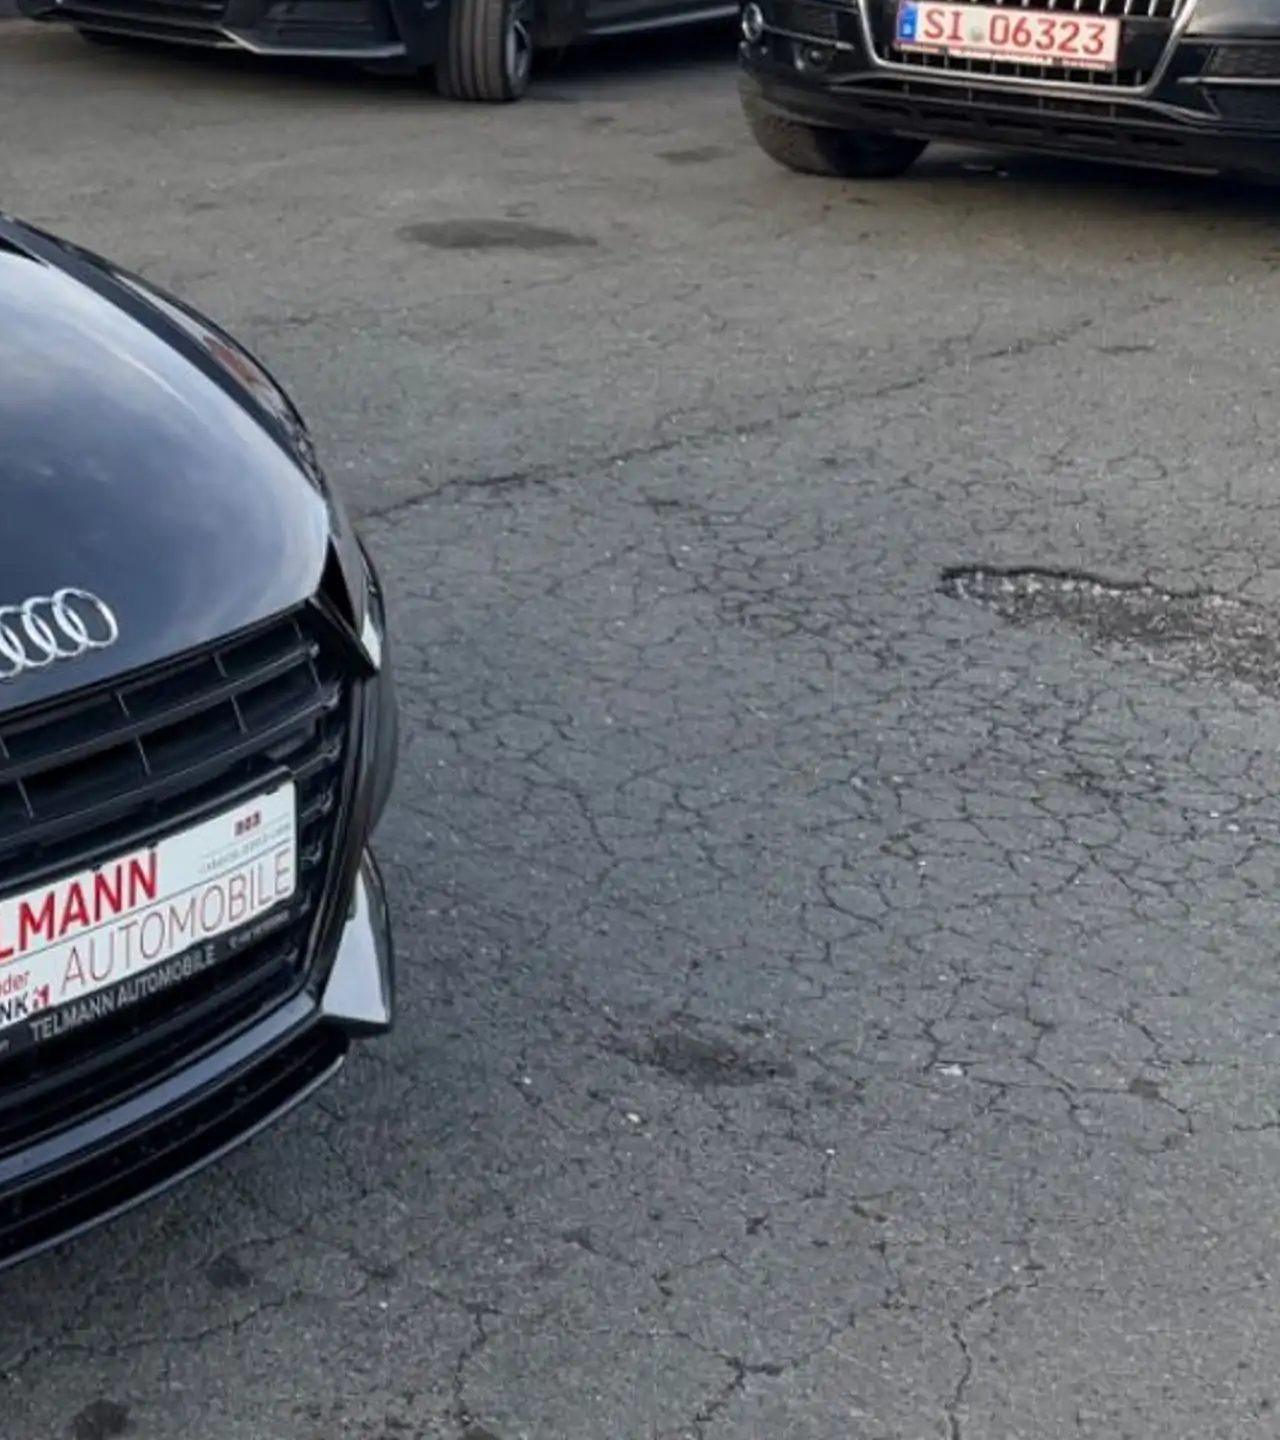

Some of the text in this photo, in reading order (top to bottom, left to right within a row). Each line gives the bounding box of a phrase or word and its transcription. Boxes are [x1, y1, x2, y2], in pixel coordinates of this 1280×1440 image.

[923, 8, 1106, 56] SI 06323
[60, 846, 291, 997] AUTOMOBILE
[28, 943, 217, 1043] TELMANN AUTOMOBILE
